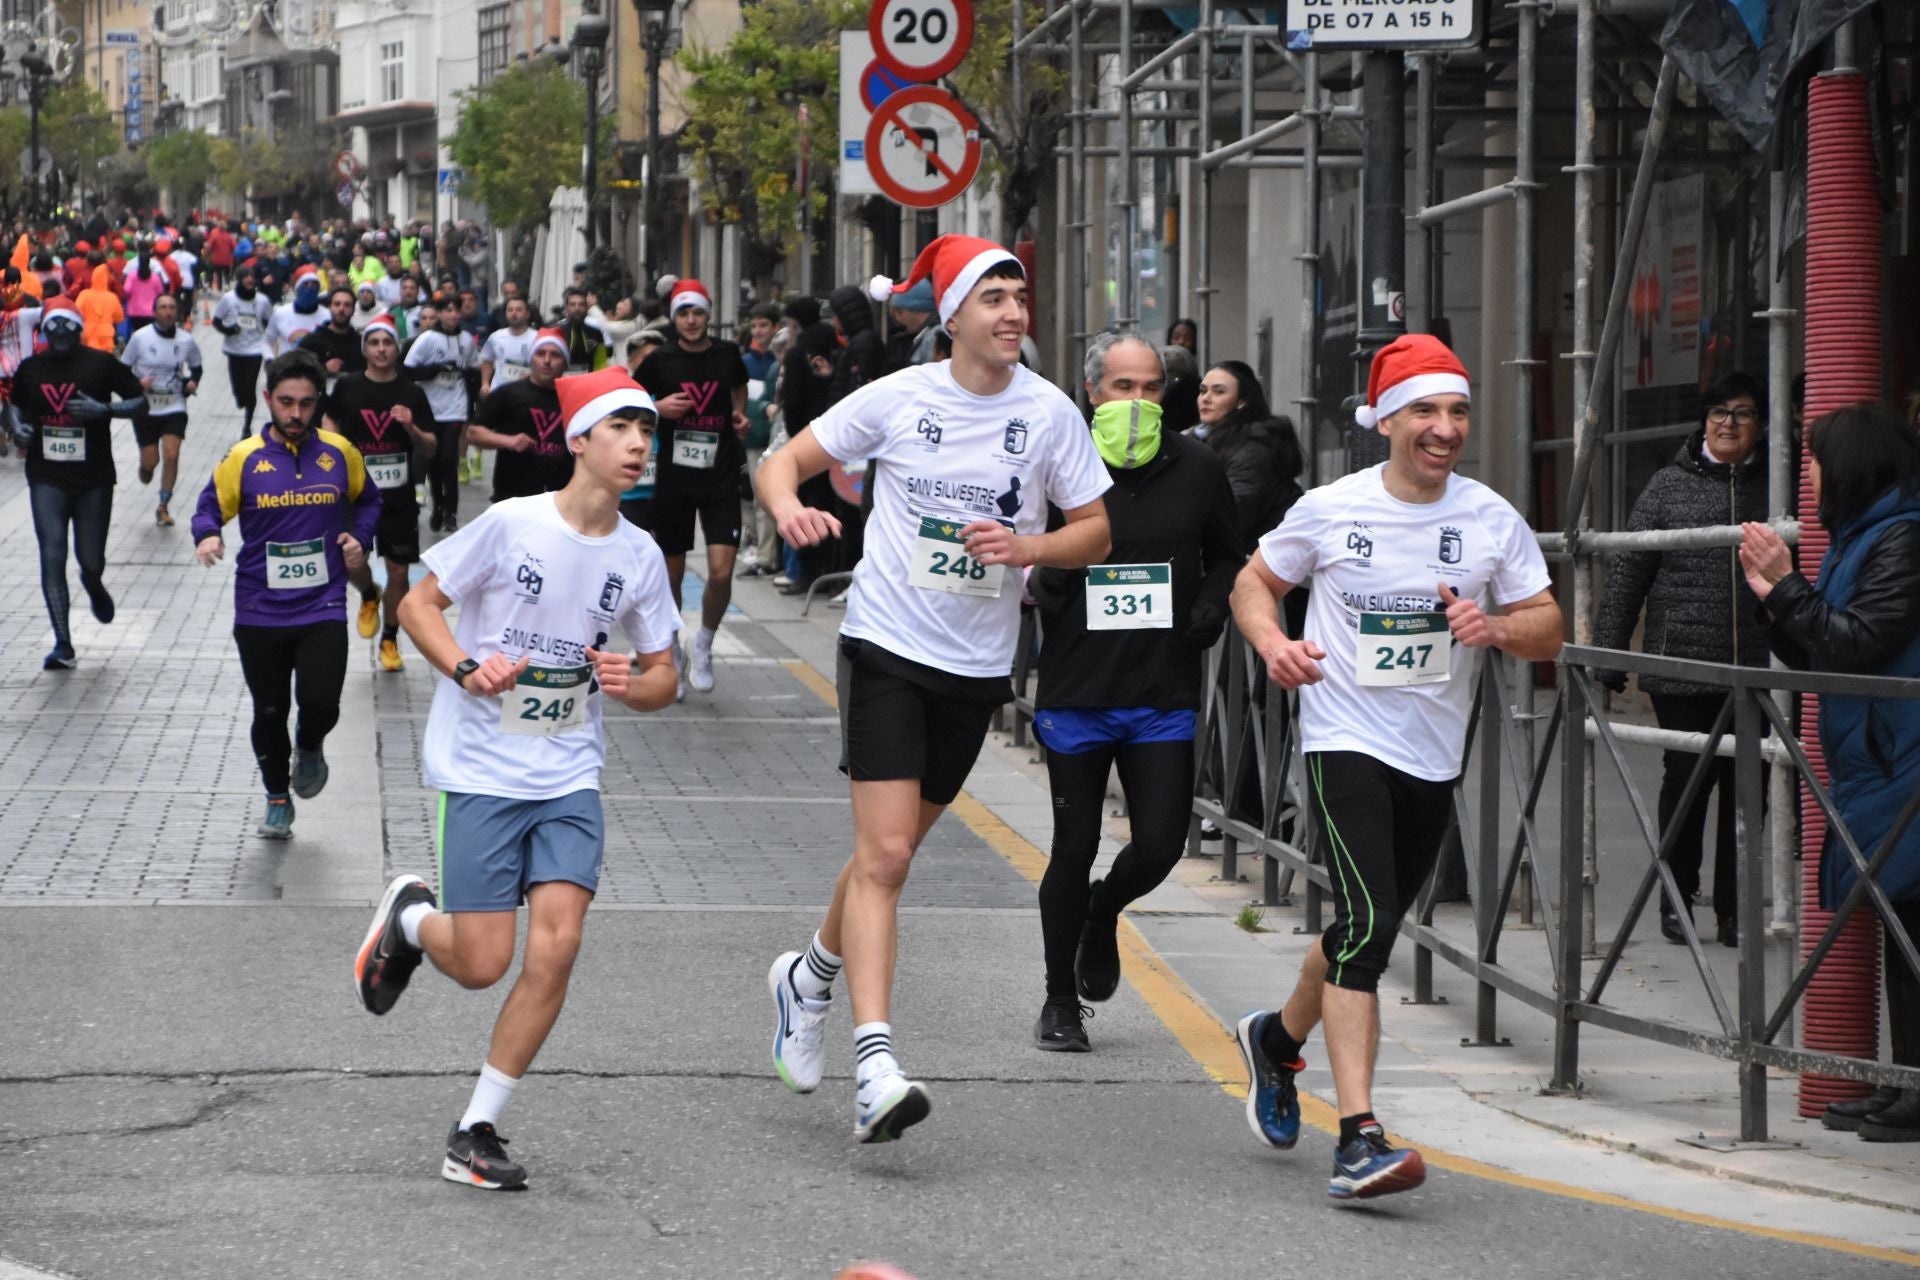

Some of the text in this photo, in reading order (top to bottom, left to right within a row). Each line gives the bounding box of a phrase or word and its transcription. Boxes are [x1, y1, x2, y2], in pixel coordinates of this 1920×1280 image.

[893, 8, 947, 43] 20
[1307, 11, 1453, 29] DE 07 A 15 h
[49, 442, 76, 454] 485
[682, 446, 709, 460] 321
[374, 469, 401, 481] 319
[256, 489, 335, 509] Mediacom
[907, 477, 996, 506] SAN SILVESTRE
[278, 562, 317, 579] 296
[928, 551, 986, 580] 248
[1103, 594, 1153, 616] 331
[1341, 592, 1432, 613] SAN SILVESTRE
[501, 627, 586, 662] SAN SILVESTRE
[1375, 644, 1433, 670] 247
[519, 696, 575, 721] 249
